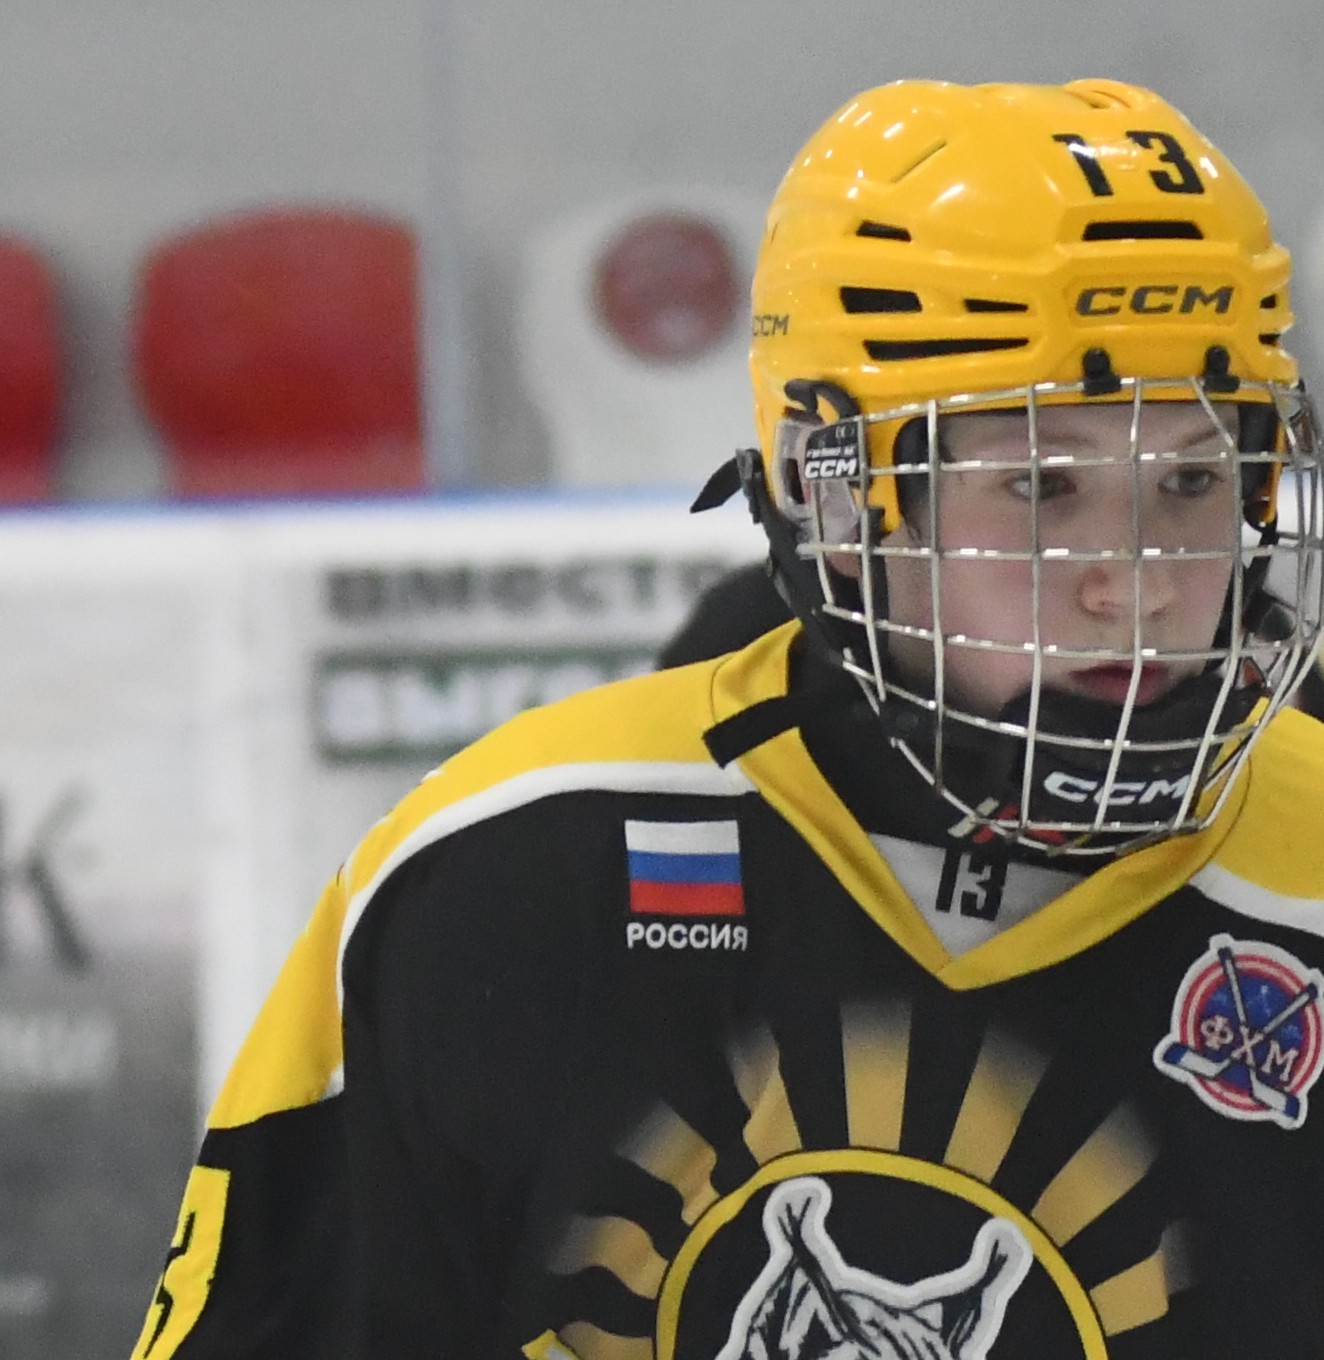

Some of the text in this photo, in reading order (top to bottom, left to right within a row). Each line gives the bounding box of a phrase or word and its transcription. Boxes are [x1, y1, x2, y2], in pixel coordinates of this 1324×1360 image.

[1075, 284, 1235, 316] CCM
[804, 458, 858, 479] CCM
[1043, 769, 1192, 806] CCM
[934, 843, 1009, 922] 13
[626, 921, 748, 952] РОССИЯ
